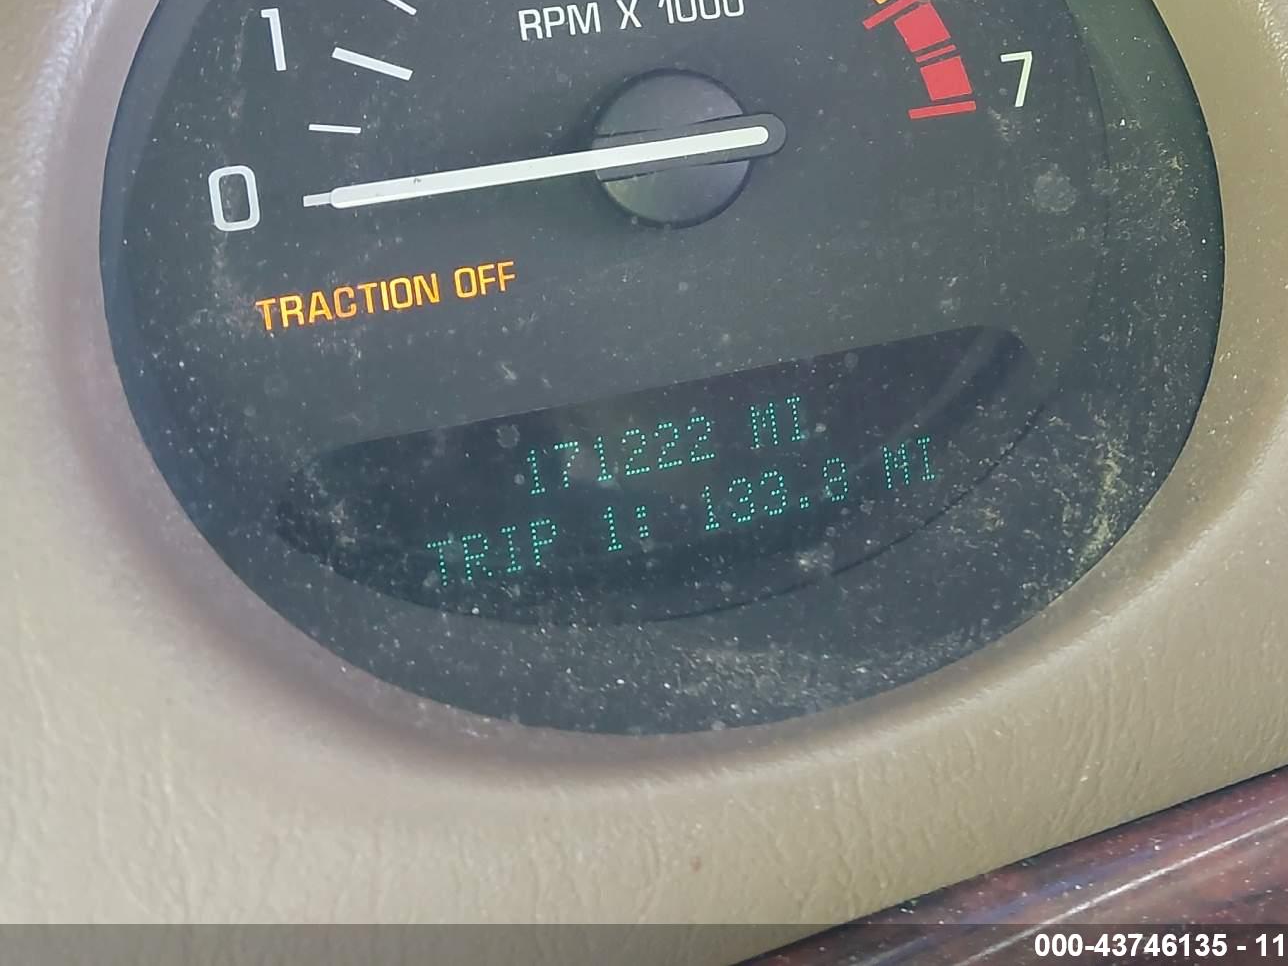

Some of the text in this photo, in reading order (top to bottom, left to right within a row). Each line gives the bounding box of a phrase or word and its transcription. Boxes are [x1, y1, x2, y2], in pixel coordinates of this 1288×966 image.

[260, 7, 287, 72] 1
[517, 1, 602, 42] RPM
[1001, 51, 1033, 108] 7
[208, 164, 260, 232] 0
[254, 260, 517, 332] TRACTION OFF
[526, 396, 803, 495] 171222 MI
[426, 518, 557, 588] TRIP
[602, 504, 650, 553] 1:
[882, 436, 937, 490] MI
